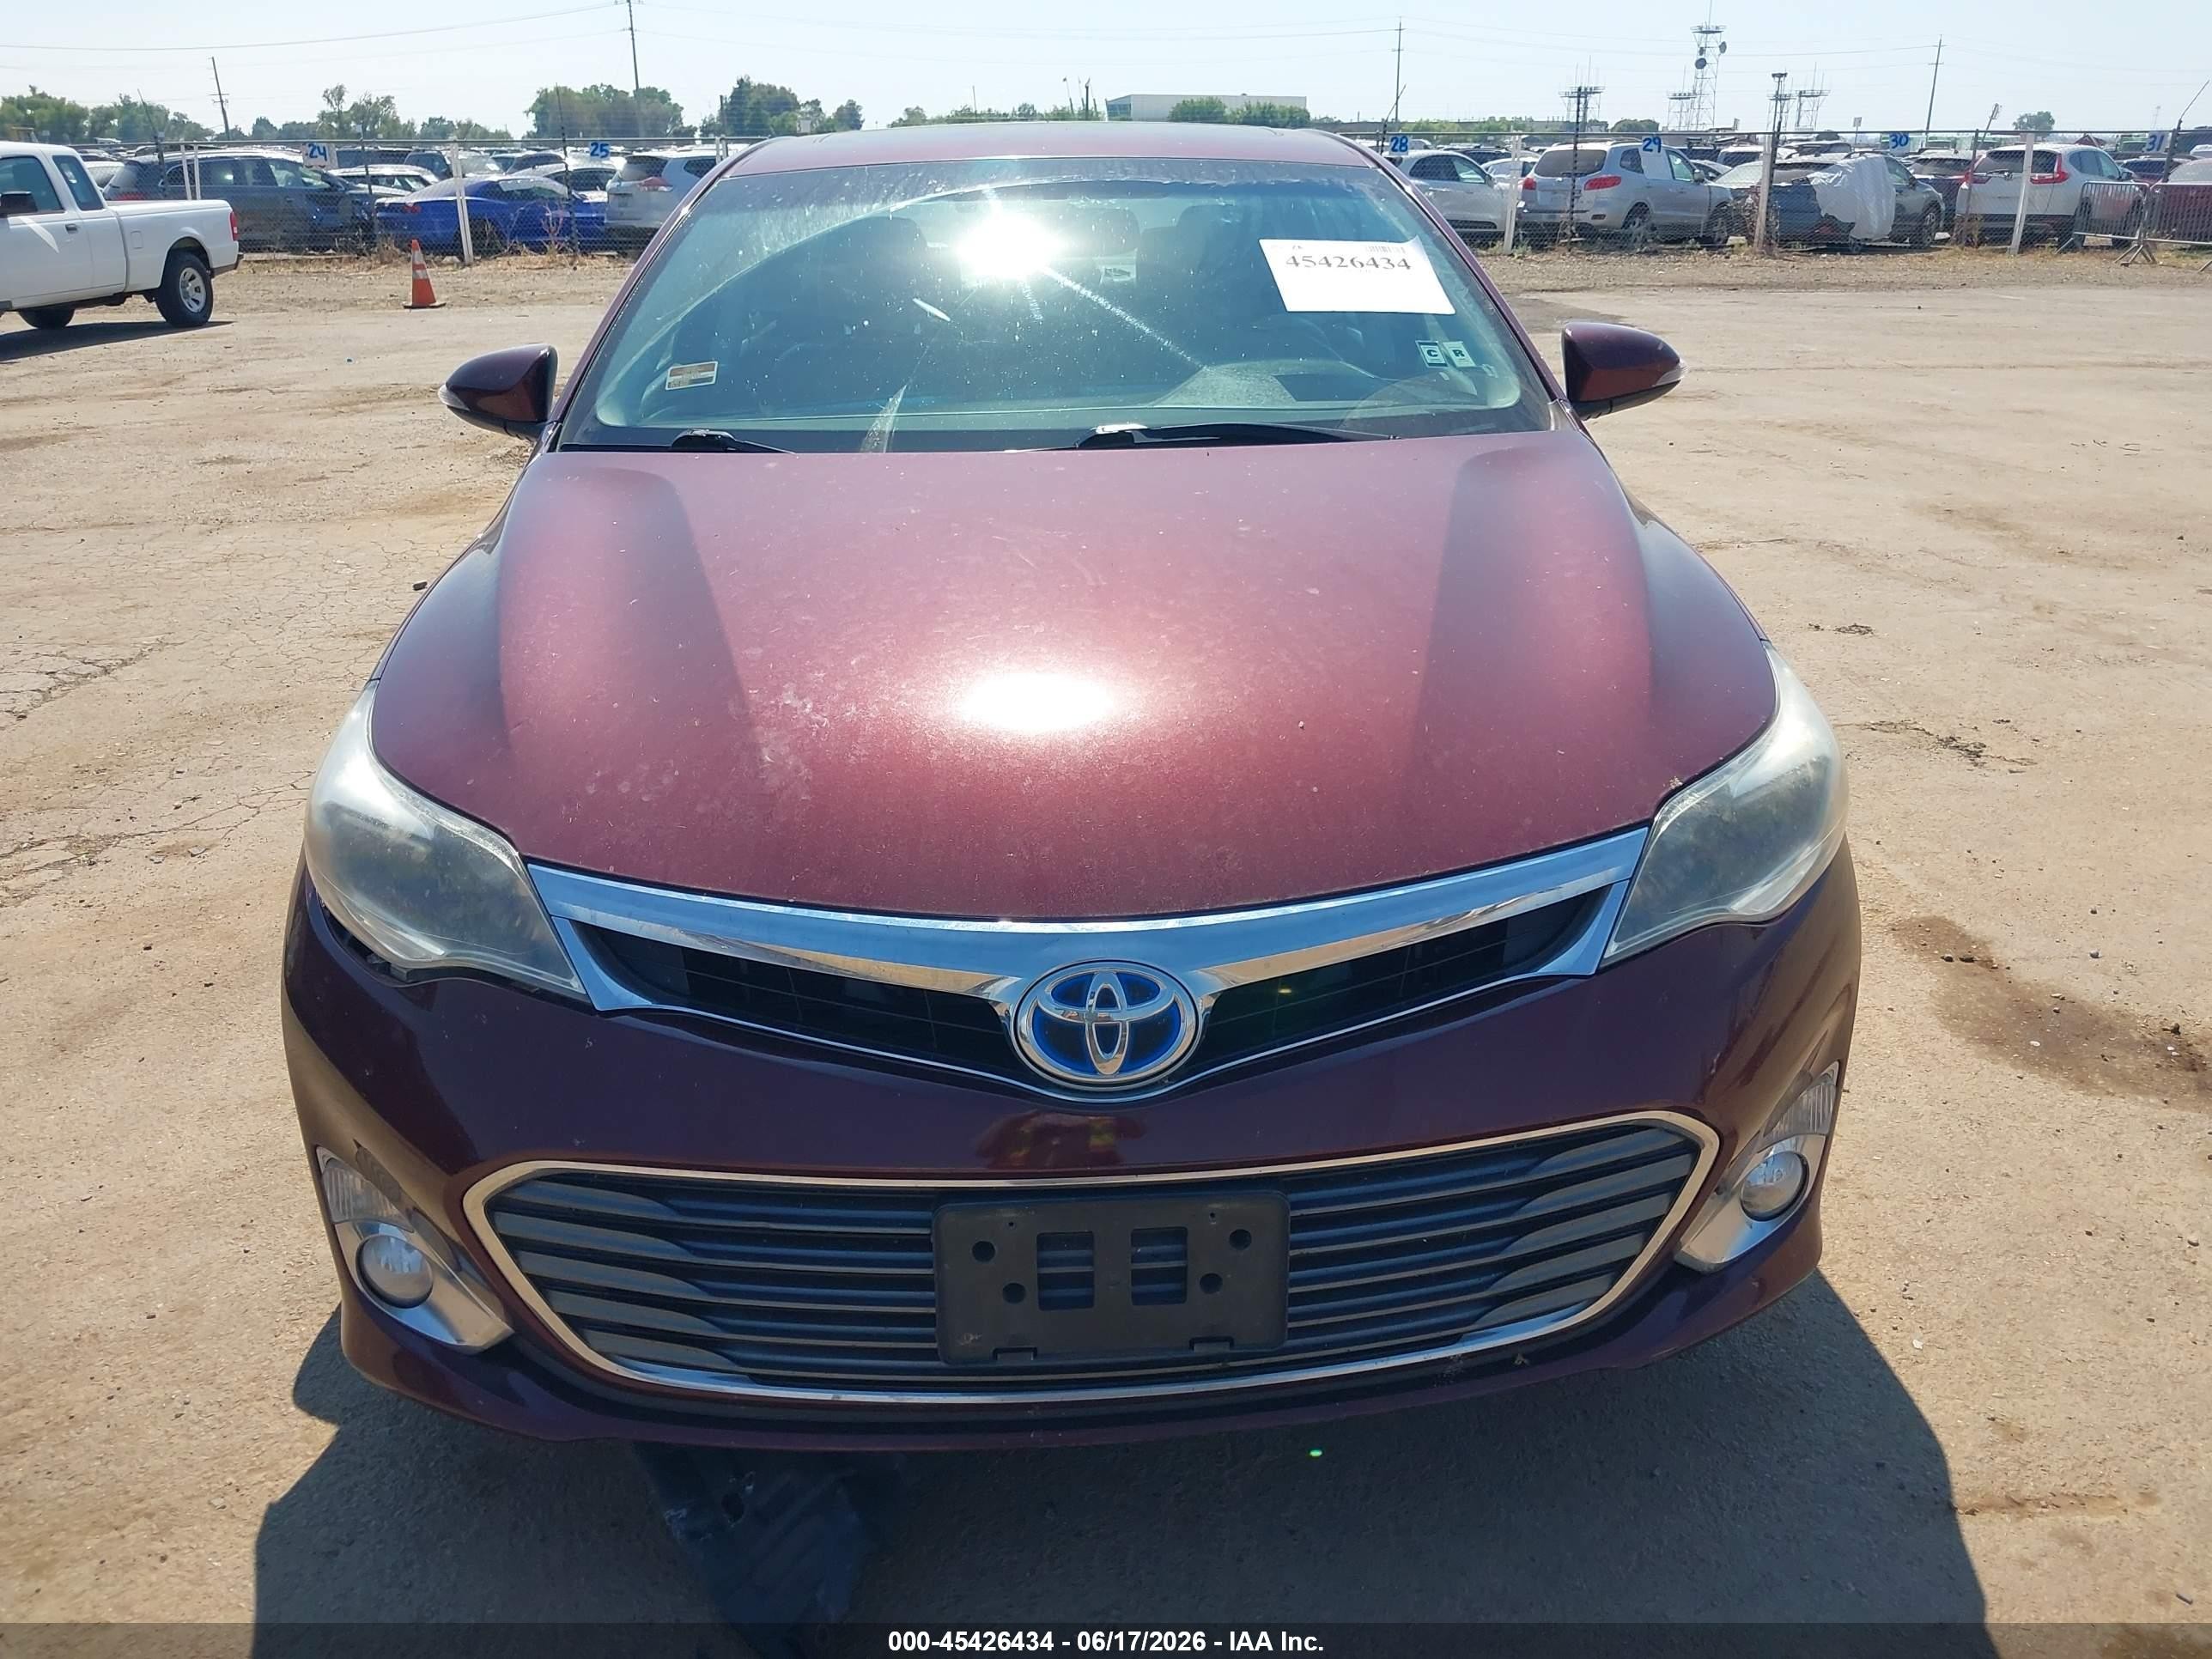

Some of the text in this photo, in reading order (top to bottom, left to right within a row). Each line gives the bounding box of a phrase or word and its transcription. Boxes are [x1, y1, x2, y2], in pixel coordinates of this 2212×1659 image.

[1390, 136, 1408, 153] 28
[1642, 137, 1662, 154] 29
[1889, 133, 1909, 149] 30
[2146, 134, 2165, 152] 31
[308, 143, 328, 161] 24
[590, 142, 610, 158] 25
[1285, 255, 1412, 270] 45426434
[1426, 349, 1438, 357] C
[1451, 349, 1465, 357] R
